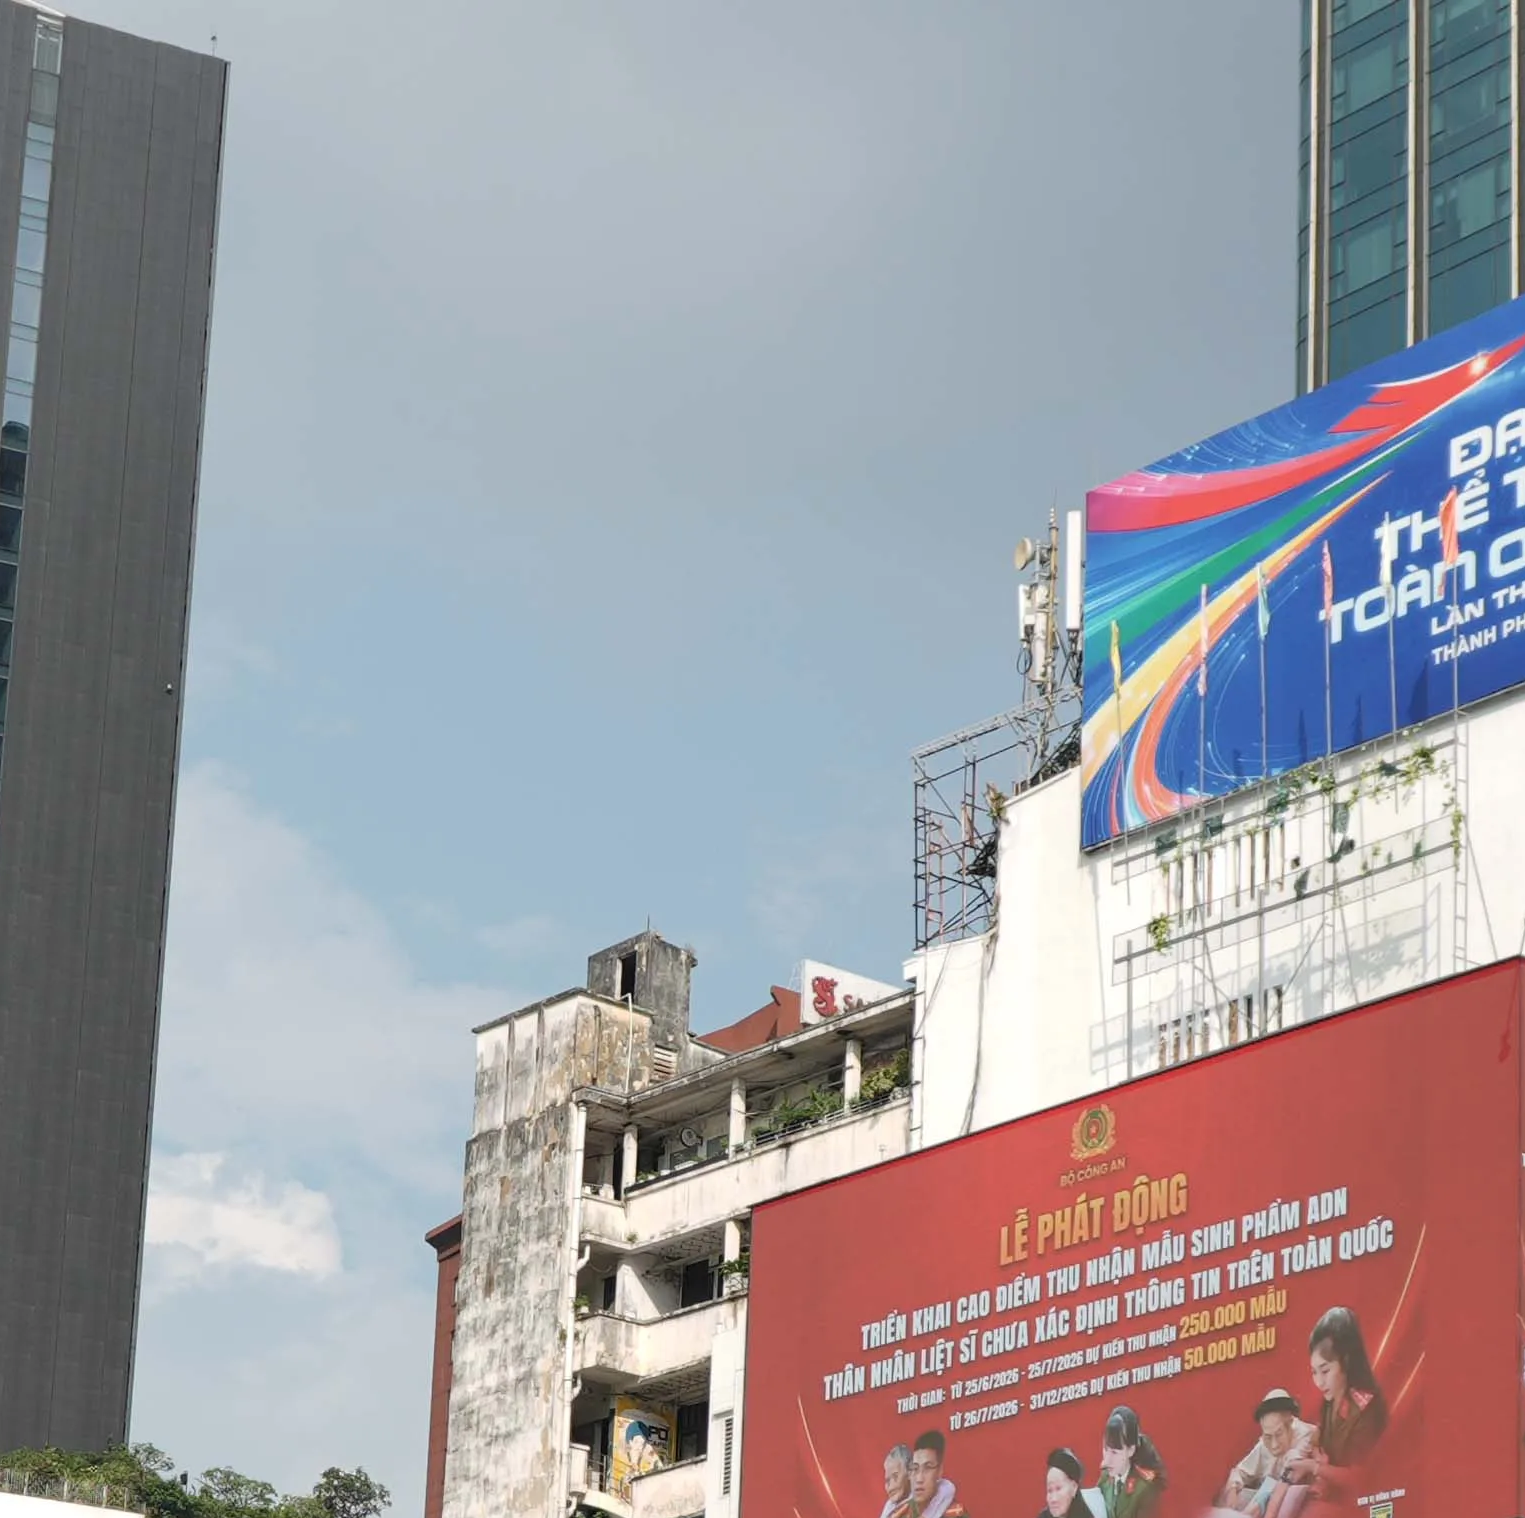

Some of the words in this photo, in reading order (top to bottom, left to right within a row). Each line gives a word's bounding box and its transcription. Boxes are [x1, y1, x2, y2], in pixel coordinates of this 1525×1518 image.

[1375, 469, 1489, 561] THỂ
[1320, 551, 1475, 643] TOÀN
[1430, 597, 1485, 635] LẦN
[1432, 629, 1496, 665] THÀNH
[1077, 1162, 1108, 1183] CÔNG
[1000, 1207, 1029, 1266] LỄ
[1037, 1193, 1105, 1256] PHÁT
[1112, 1173, 1188, 1236] ĐỘNG
[824, 1363, 865, 1401] THÂN
[871, 1349, 915, 1388] NHÂN
[921, 1338, 955, 1376] LIỆT
[959, 1329, 978, 1363] SĨ
[982, 1320, 1029, 1357] CHƯA
[1034, 1306, 1071, 1344] XÁC
[1076, 1295, 1119, 1335] ĐỊNH
[1124, 1278, 1185, 1319] THÔNG
[1191, 1267, 1221, 1300] TIN
[1227, 1249, 1275, 1290] TRÊN
[1281, 1234, 1332, 1276] TOÀN
[1339, 1214, 1394, 1260] QUỐC
[862, 1308, 906, 1350] TRIỂN
[912, 1301, 952, 1337] KHAI
[956, 1290, 990, 1324] CAO
[996, 1272, 1041, 1313] ĐIỂM
[1047, 1263, 1080, 1296] THU
[1086, 1246, 1135, 1285] NHẬN
[1142, 1229, 1185, 1271] MẪU
[1191, 1219, 1235, 1257] SINH
[1242, 1198, 1300, 1243] PHẨM
[1308, 1187, 1347, 1225] ADN
[1128, 1333, 1146, 1353] THU
[1149, 1324, 1177, 1348] NHẬN
[1179, 1300, 1246, 1340] 250.000
[1250, 1284, 1288, 1322] MẪU
[1132, 1365, 1152, 1385] THU
[1154, 1354, 1182, 1379] NHẬN
[1184, 1343, 1237, 1371] 50.000
[1242, 1323, 1276, 1357] MẪU
